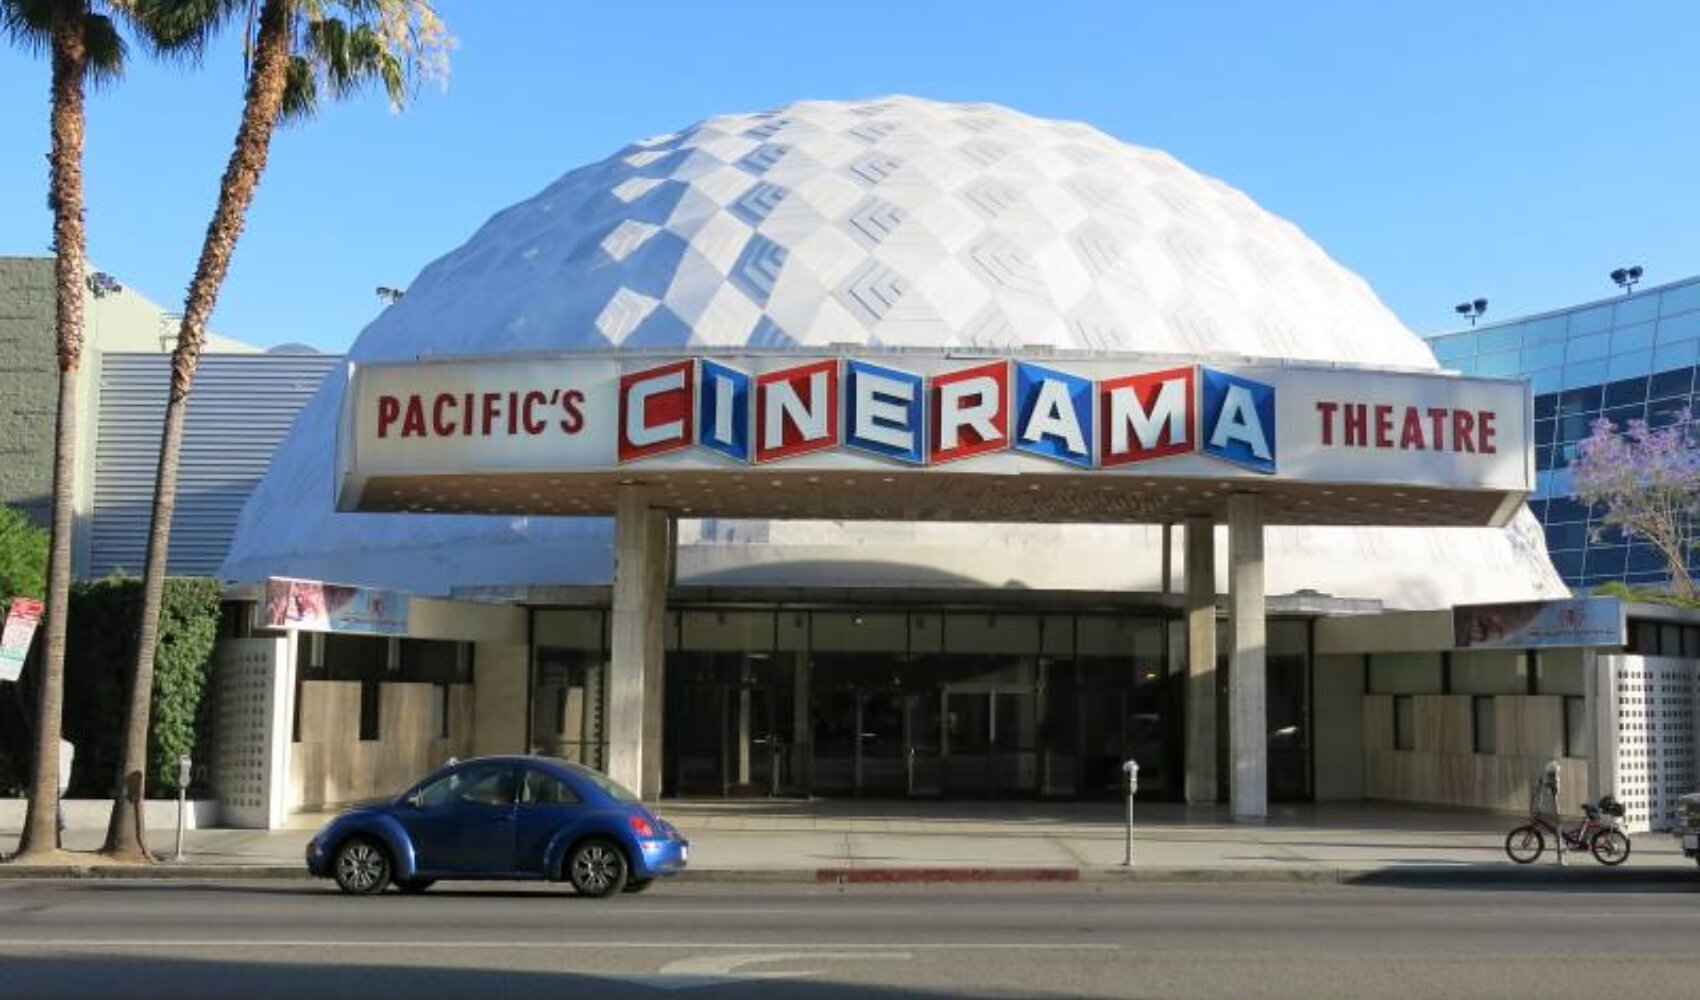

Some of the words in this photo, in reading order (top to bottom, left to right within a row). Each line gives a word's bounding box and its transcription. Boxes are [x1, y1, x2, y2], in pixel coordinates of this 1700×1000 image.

[377, 388, 586, 439] PACIFIC'S
[626, 369, 1273, 461] CINERAMA
[1316, 402, 1497, 454] THEATRE
